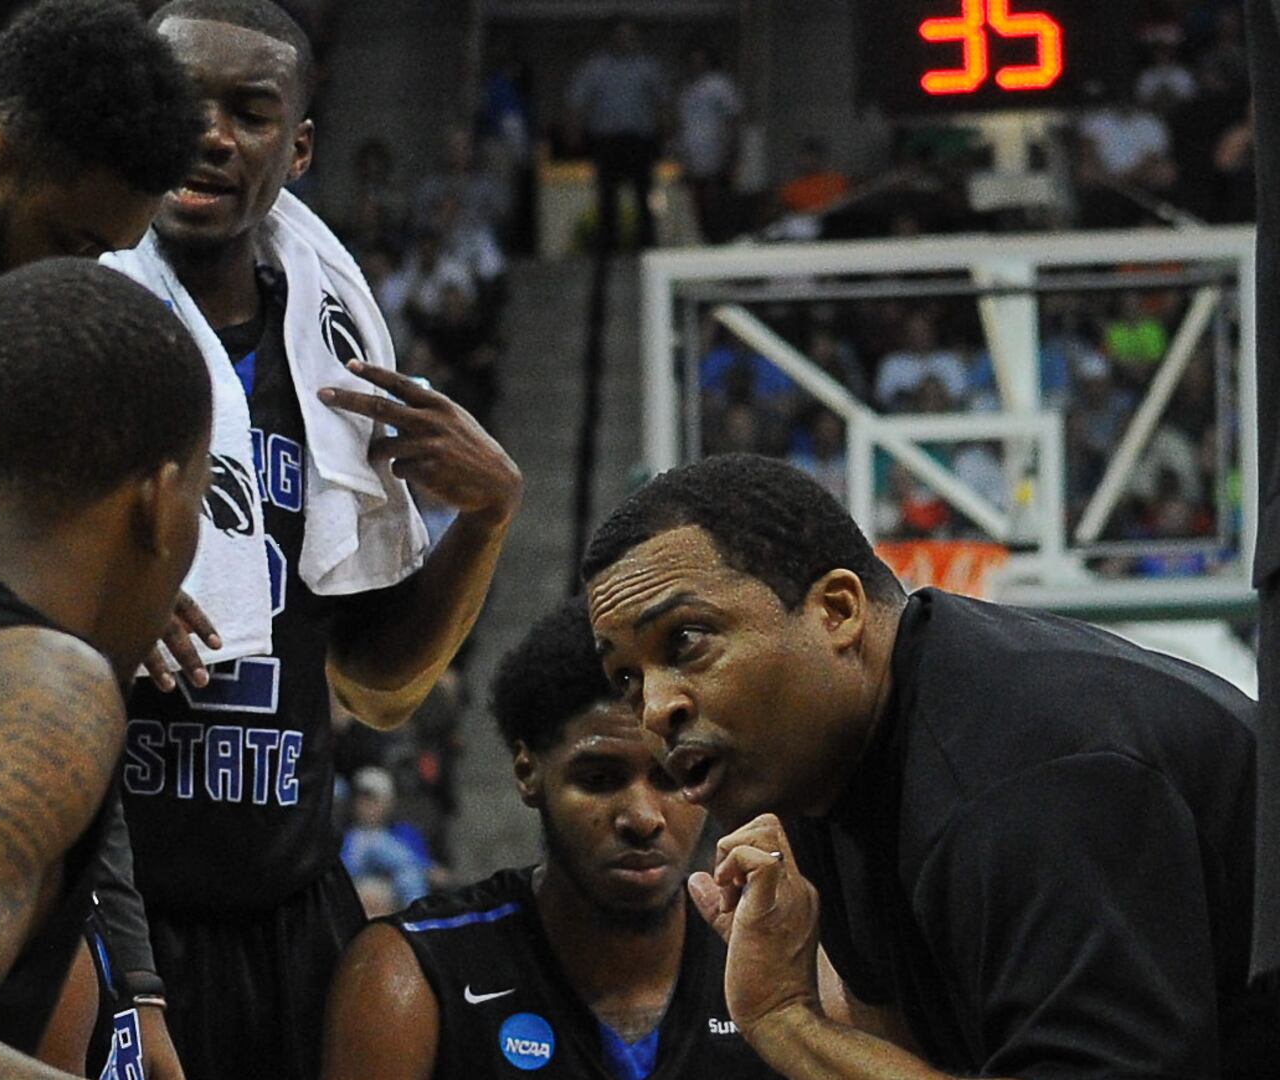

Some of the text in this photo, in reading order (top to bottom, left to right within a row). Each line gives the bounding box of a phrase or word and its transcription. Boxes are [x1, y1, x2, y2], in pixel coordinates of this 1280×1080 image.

[919, 0, 1063, 95] 35
[124, 719, 304, 806] STATE
[506, 1037, 551, 1059] NCAA
